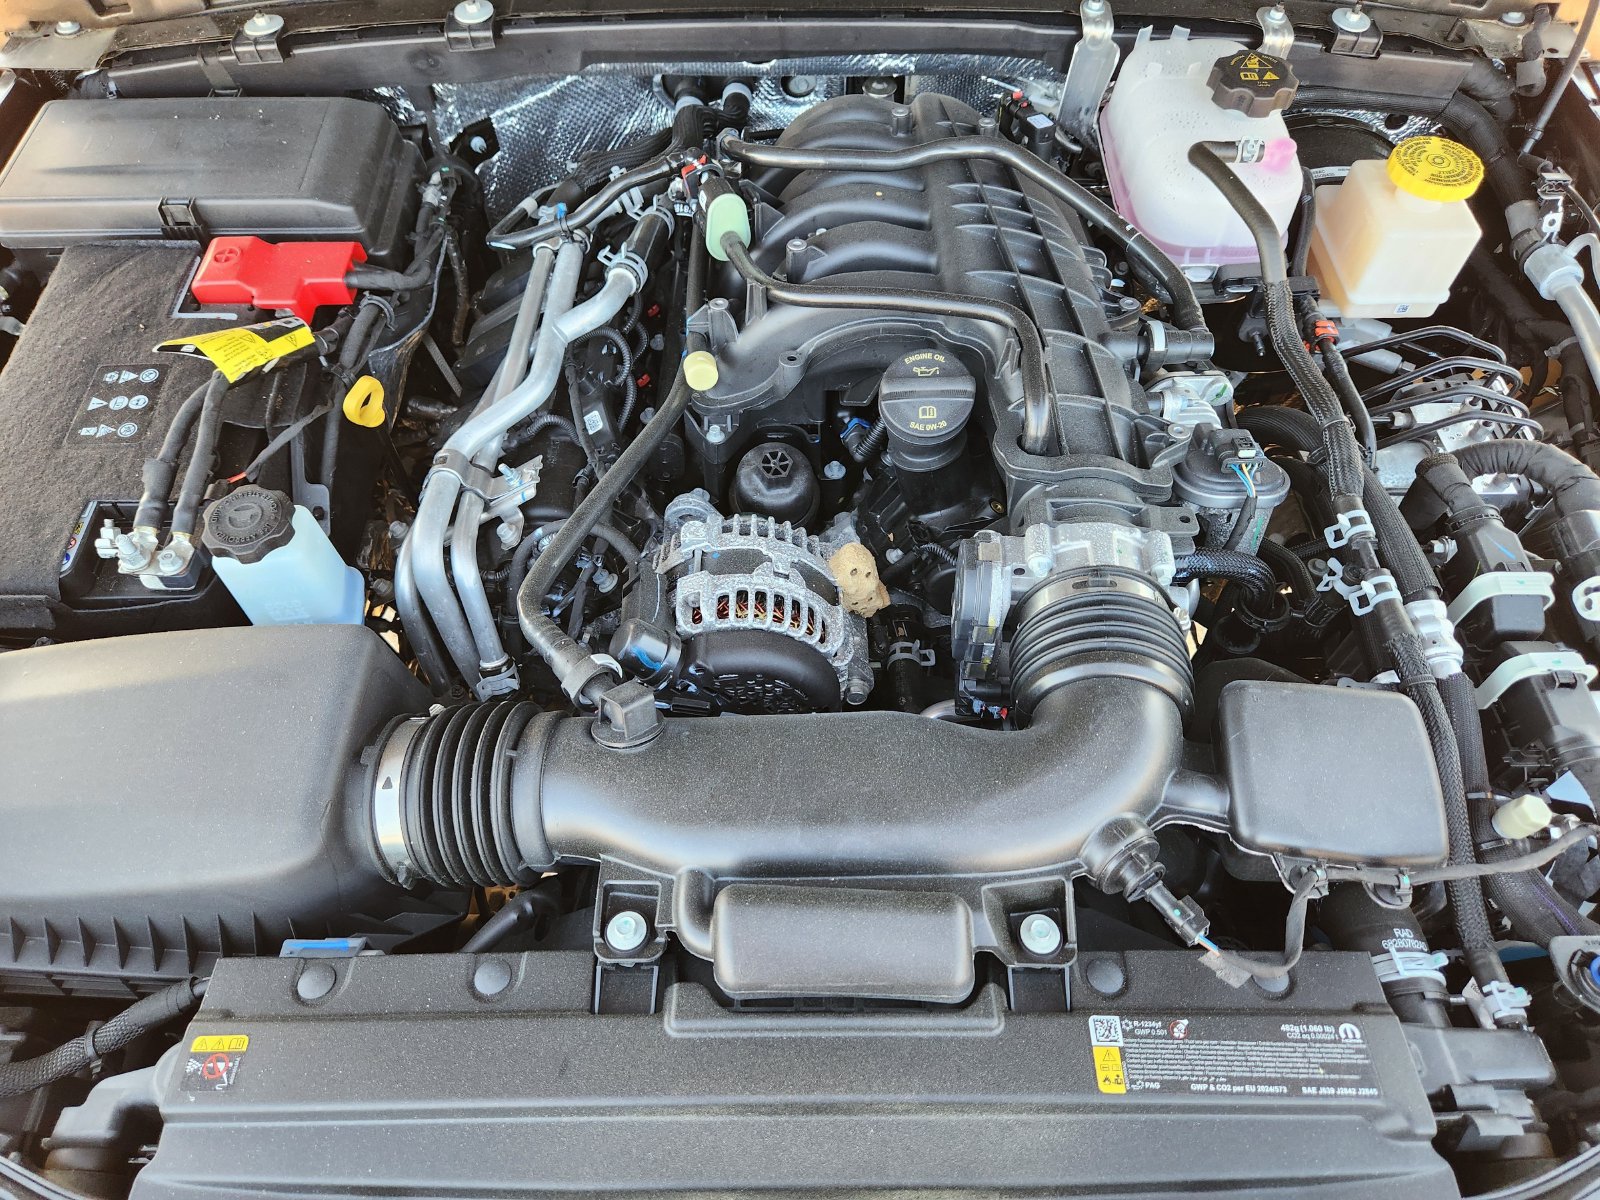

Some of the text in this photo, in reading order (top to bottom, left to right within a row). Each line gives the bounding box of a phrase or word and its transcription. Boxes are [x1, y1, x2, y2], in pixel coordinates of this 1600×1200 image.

[904, 353, 946, 364] ENGINE OIL
[909, 421, 947, 431] SAE 0W-20
[1393, 928, 1414, 938] RAD
[1324, 1025, 1335, 1033] lb)
[1190, 1083, 1208, 1091] GWP
[1233, 1085, 1244, 1093] per
[1301, 1086, 1318, 1094] SAE
